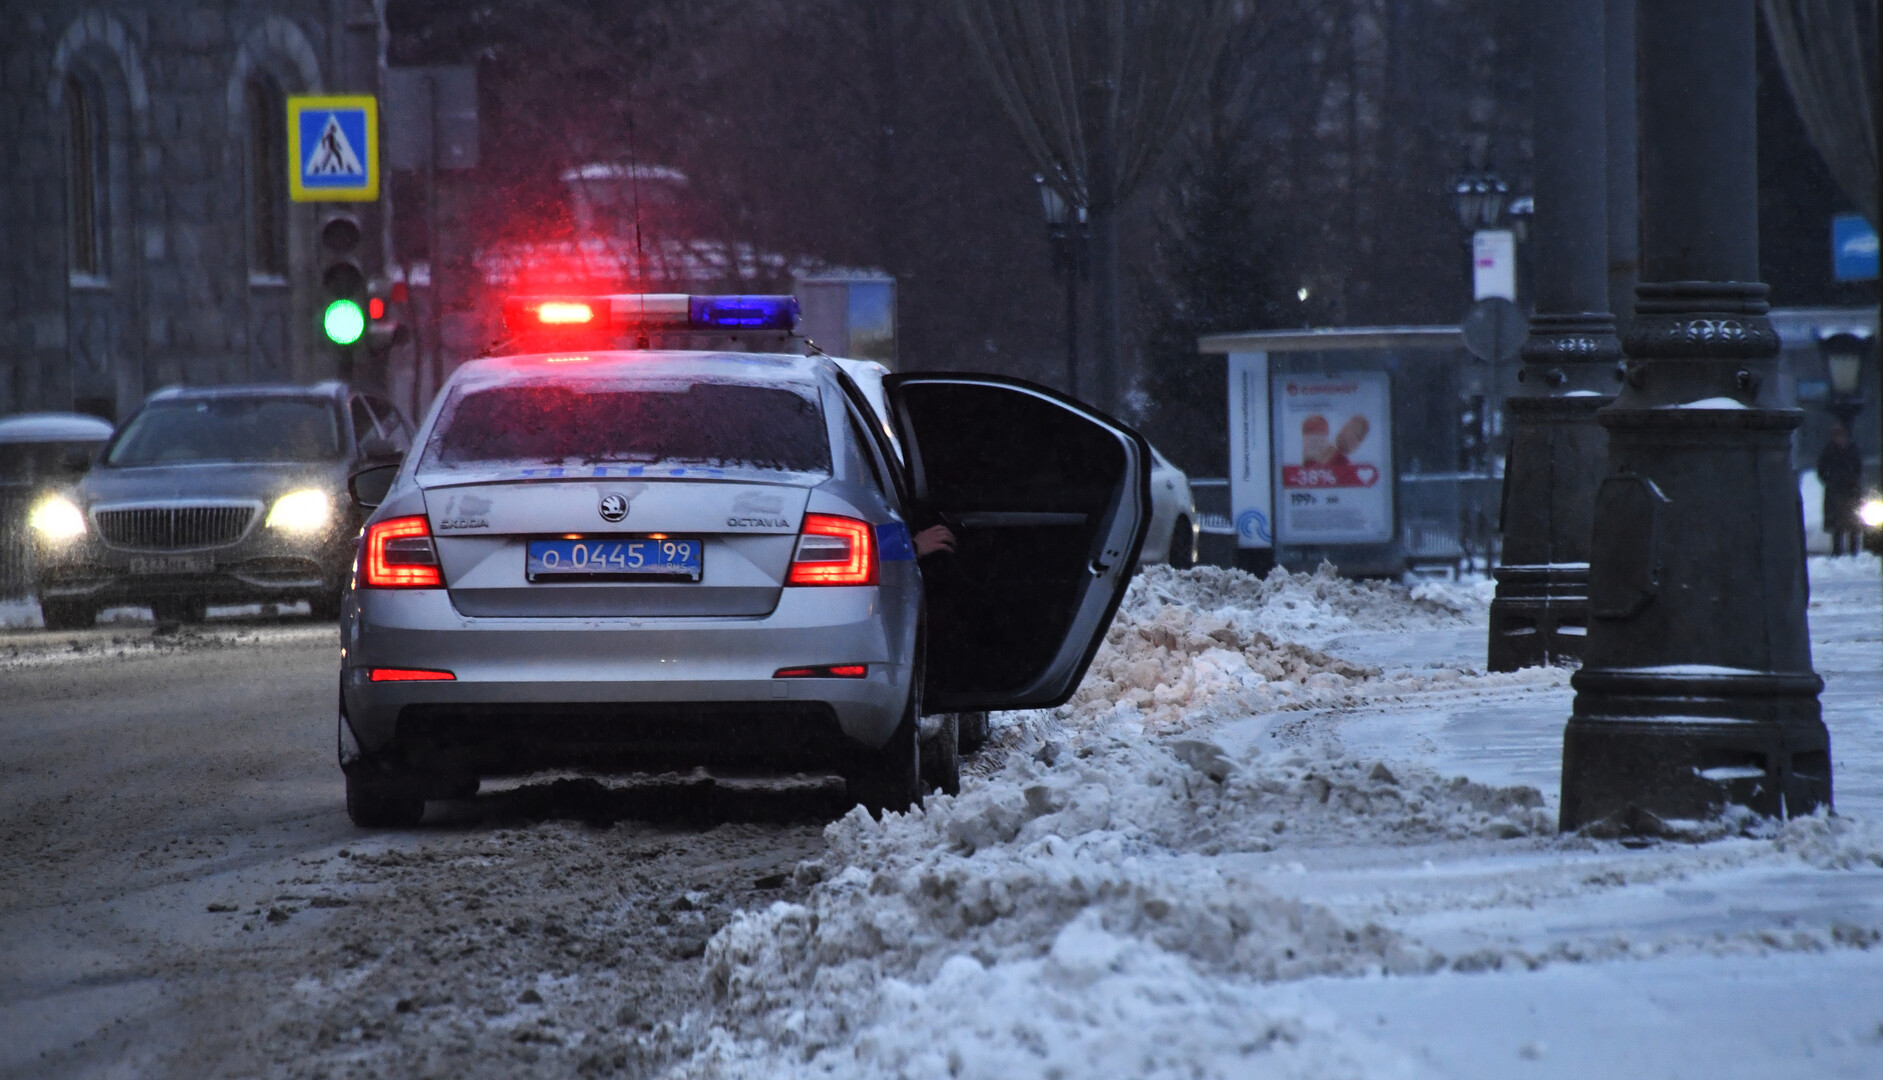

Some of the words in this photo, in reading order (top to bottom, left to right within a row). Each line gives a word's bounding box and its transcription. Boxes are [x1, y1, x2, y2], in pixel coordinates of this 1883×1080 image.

[1290, 469, 1337, 485] -38%
[727, 518, 790, 528] OCTAVIA
[572, 544, 644, 569] 0445
[663, 542, 691, 562] 99
